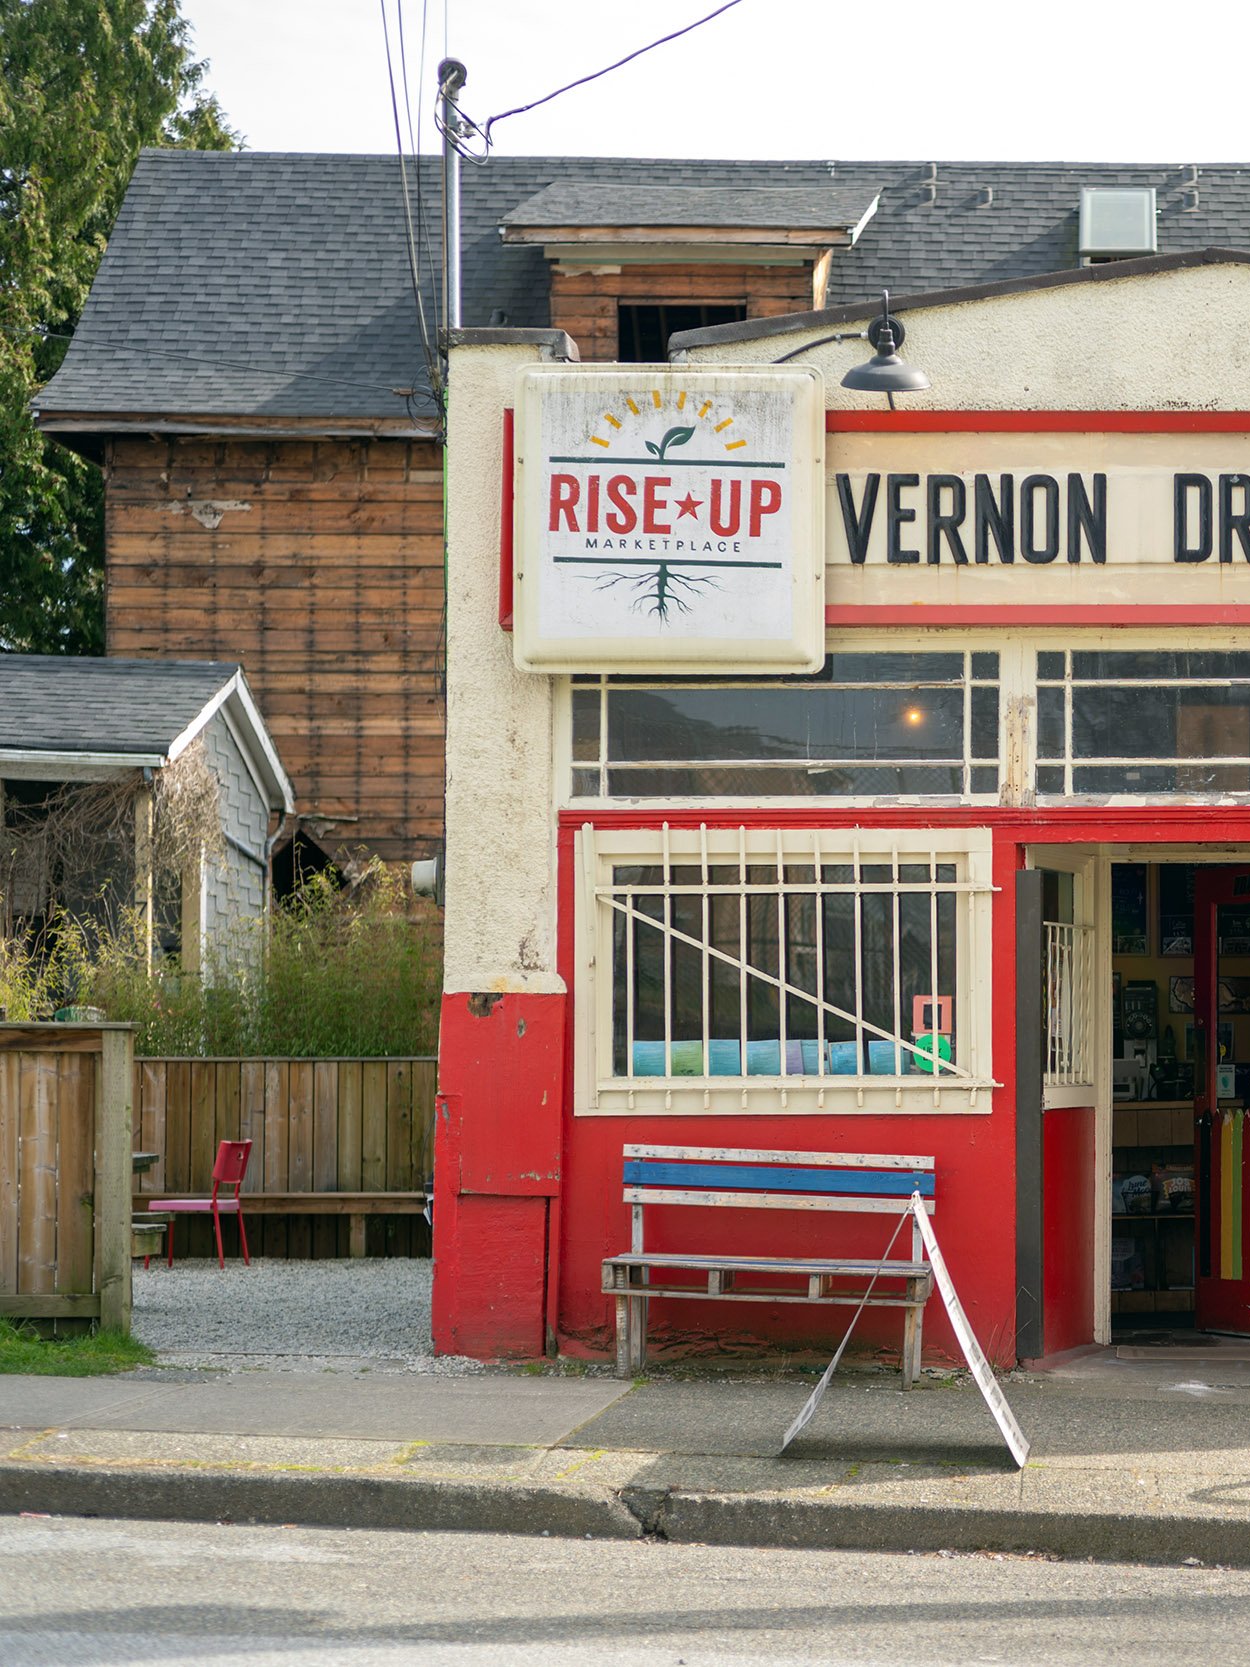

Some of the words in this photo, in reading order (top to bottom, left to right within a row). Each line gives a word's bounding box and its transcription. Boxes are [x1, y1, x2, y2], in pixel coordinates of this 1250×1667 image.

[549, 473, 673, 536] RISE
[709, 478, 782, 538] UP
[835, 473, 1107, 565] VERNON
[585, 537, 741, 554] MARKETPLACE
